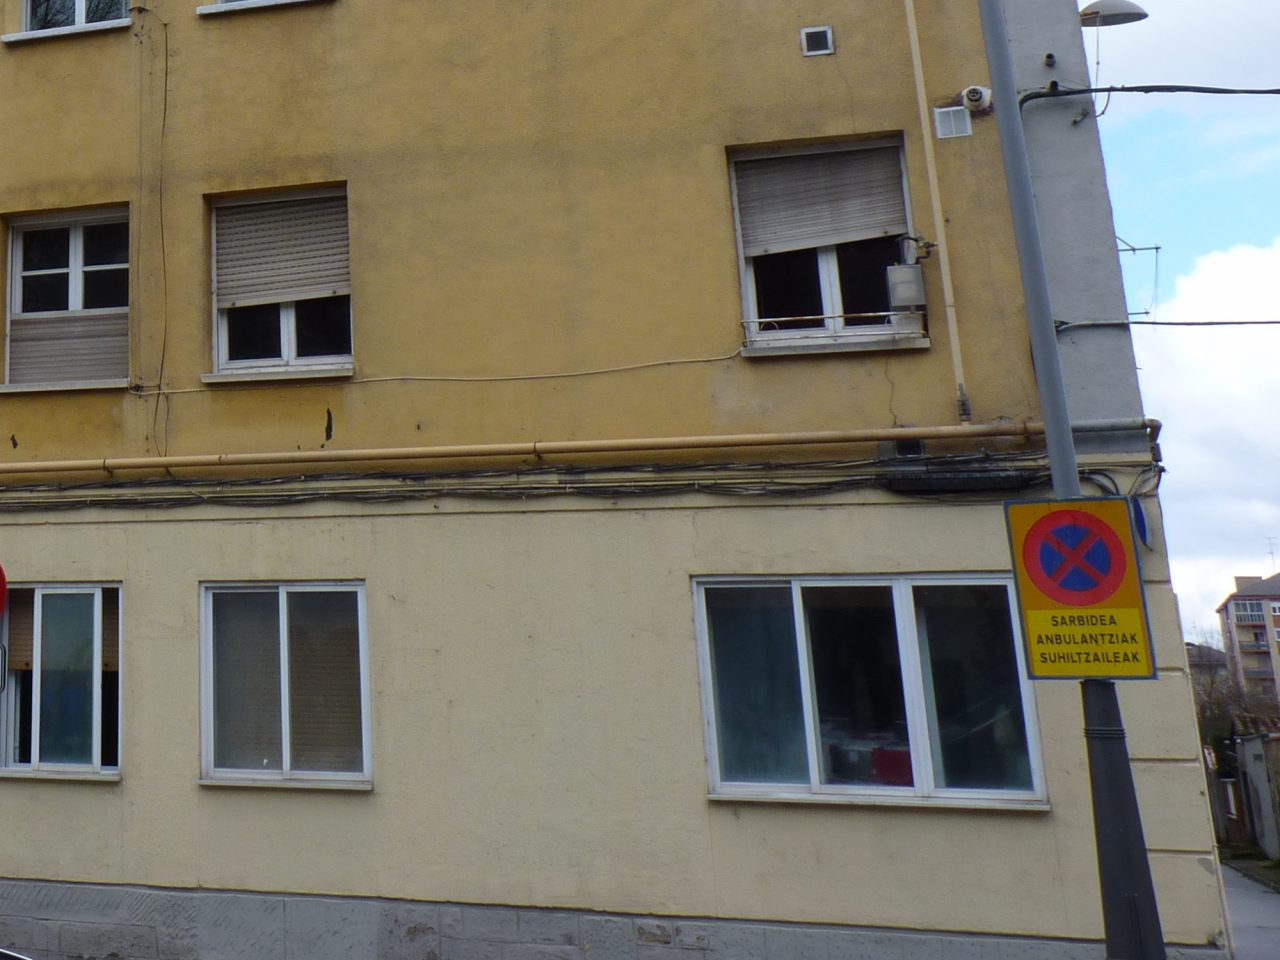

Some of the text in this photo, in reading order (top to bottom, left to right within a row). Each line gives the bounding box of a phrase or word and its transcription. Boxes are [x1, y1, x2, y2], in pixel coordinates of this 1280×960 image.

[1051, 615, 1117, 627] SARBIDEA
[1037, 633, 1138, 645] ANBULANTZIAK
[1040, 652, 1139, 664] SUHILTZAILEAK
